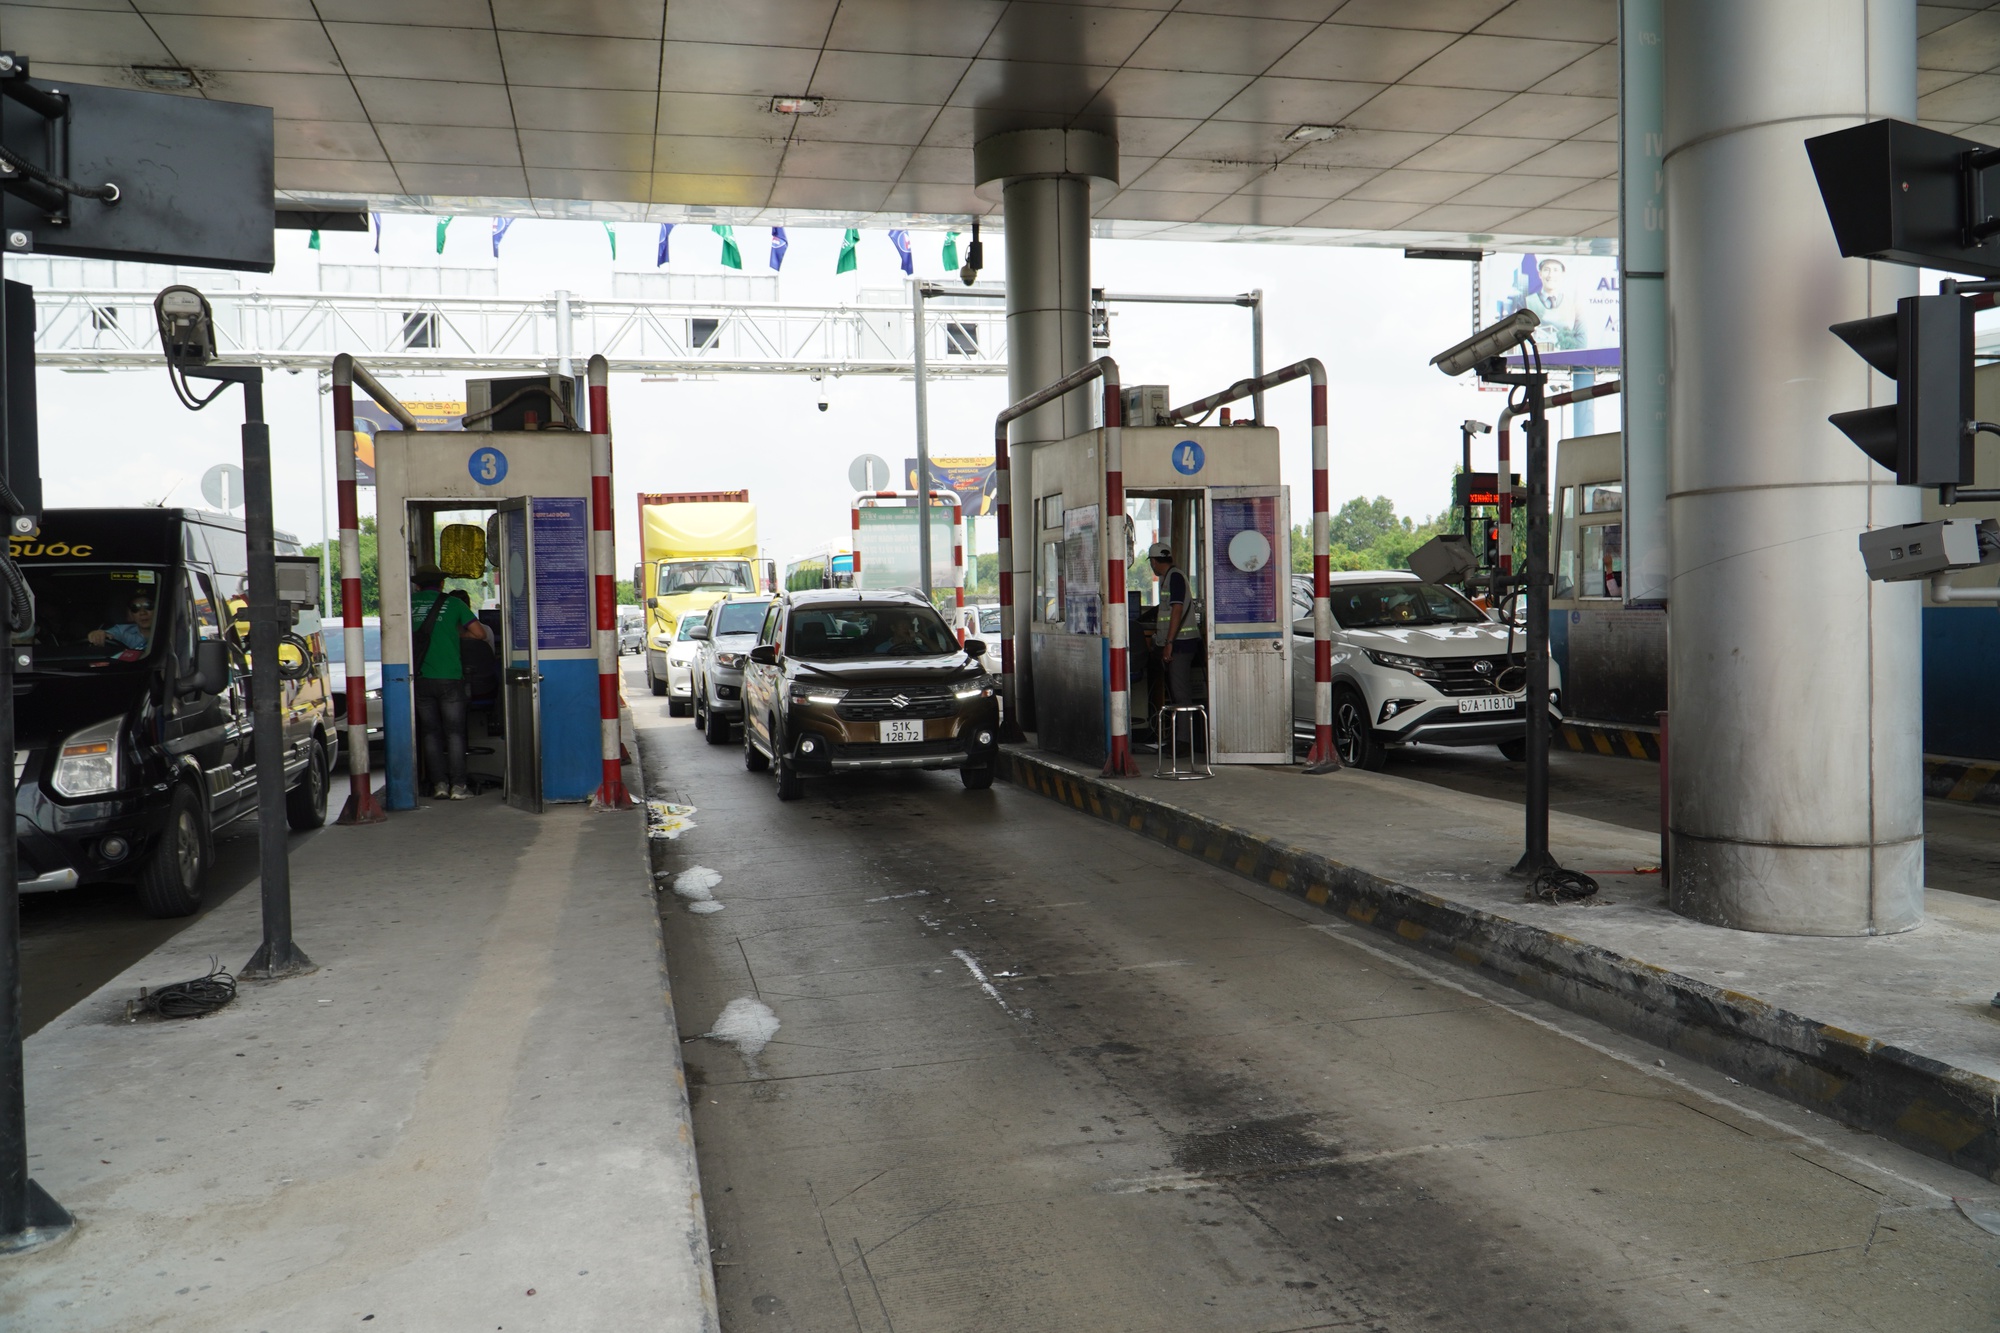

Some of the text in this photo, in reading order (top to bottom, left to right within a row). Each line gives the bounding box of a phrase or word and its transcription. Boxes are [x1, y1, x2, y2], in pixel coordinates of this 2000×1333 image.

[1182, 446, 1196, 469] 4
[481, 453, 496, 480] 3
[1461, 697, 1513, 712] 67A-118.10
[892, 721, 911, 731] 51K
[886, 731, 919, 742] 128.72
